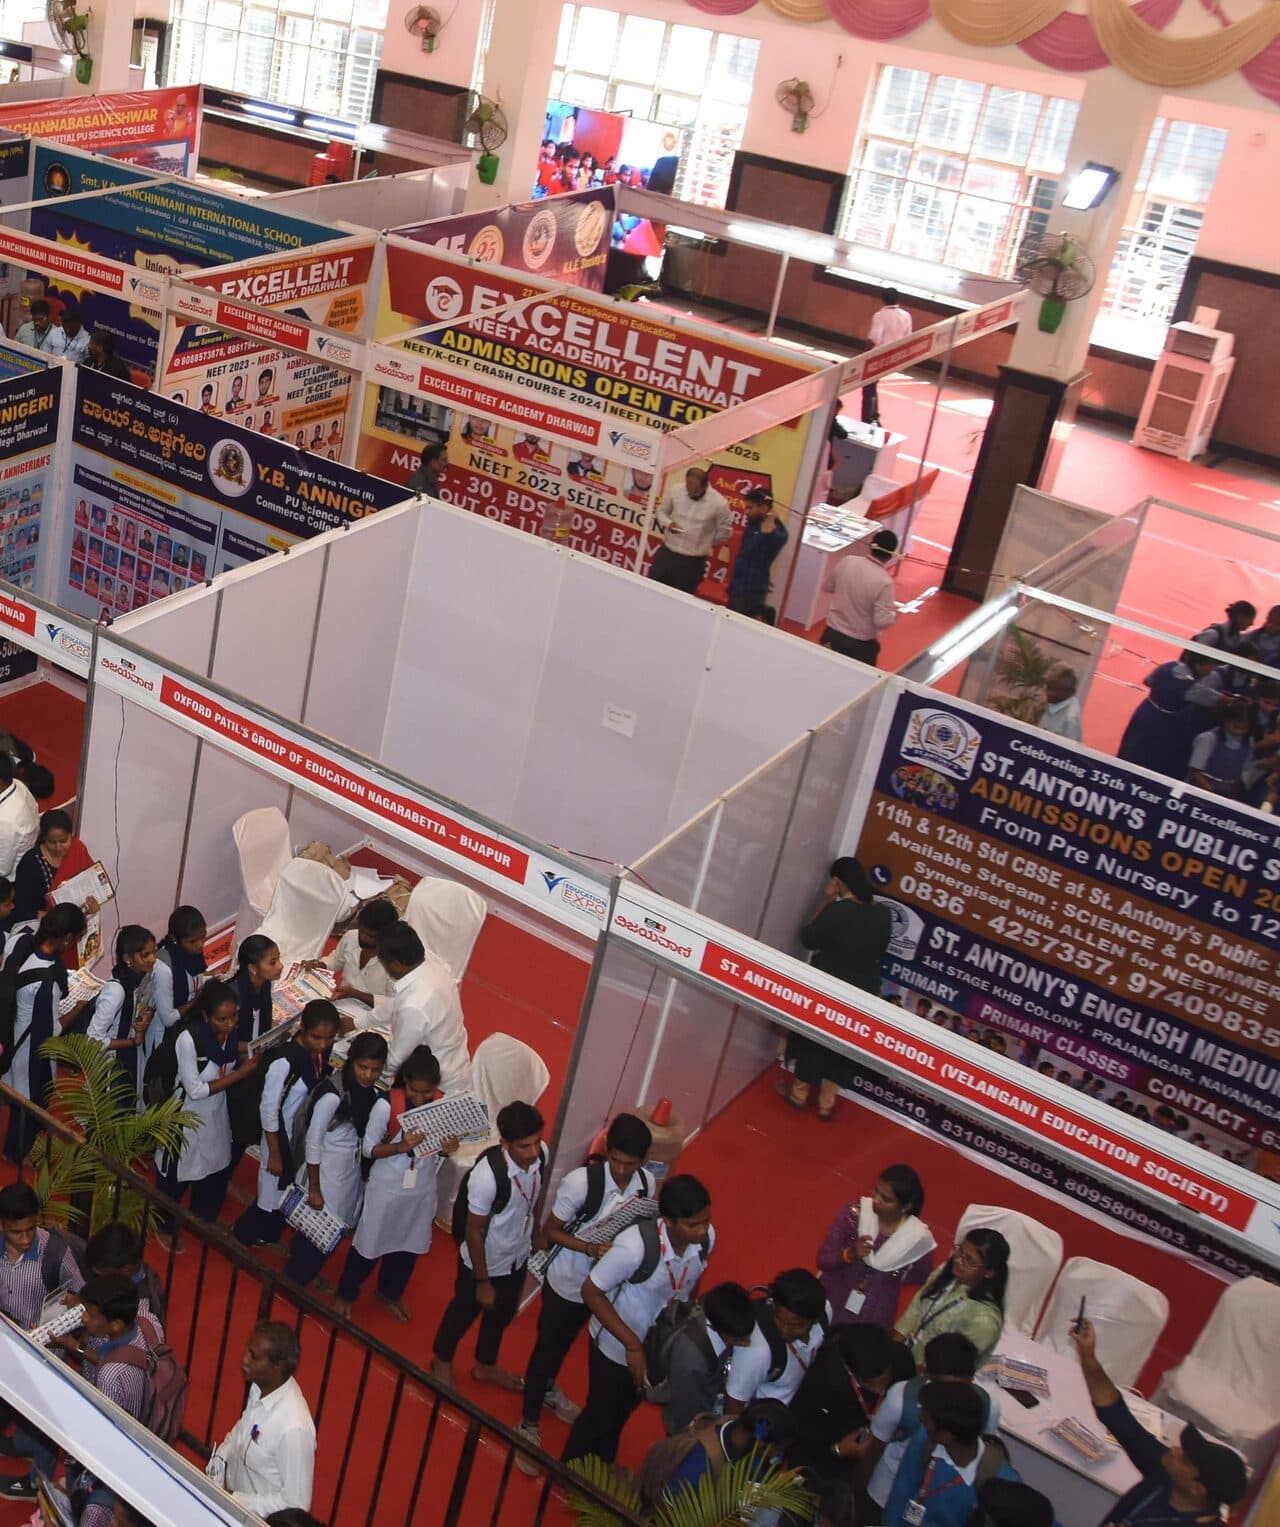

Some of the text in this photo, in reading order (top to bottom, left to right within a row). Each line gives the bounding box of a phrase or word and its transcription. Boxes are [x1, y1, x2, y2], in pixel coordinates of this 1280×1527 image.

[122, 124, 156, 136] COLLEGE
[186, 203, 303, 248] INTERNATIONAL SCHOOL
[48, 251, 86, 275] INSTITUTES
[86, 262, 122, 284] DHARWAD
[224, 305, 304, 337] EXCELLENT ACADEMY
[246, 322, 276, 339] DHARWAD
[468, 317, 627, 378] NEET ACADEMY,
[470, 285, 762, 396] EXCELLENT
[441, 330, 662, 414] ADMISSIONS OPEN
[472, 362, 602, 410] CRASH COURSE 2024
[16, 424, 49, 442] Dharwad
[422, 374, 596, 438] EXCELLENT ACADEMY DHARWAD
[3, 454, 52, 479] ANNIGERIAN'S
[468, 454, 513, 479] NEET
[516, 470, 562, 498] 2023
[173, 690, 512, 868] OXFORD PATIL'S GROUP EDUCATION NAGARABETTA BIJAPUR
[1008, 740, 1270, 844] Celebrating Excellence
[968, 778, 1249, 898] ADMISSIONS OPEN
[981, 750, 1258, 872] ST. ANTONY'S PUBLIC
[887, 830, 1156, 949] Available Stream SCIENCE
[980, 809, 1200, 910] From Pre Nursery
[900, 875, 966, 916] 0836
[1011, 854, 1270, 972] CBSE Antony's Public
[914, 861, 1270, 1016] Synergised ALLEN NEET/JEE
[890, 964, 960, 1002] PRIMARY
[930, 926, 1190, 1054] ST. ANTONY'S ENGLISH
[946, 966, 990, 992] STAGE
[980, 1004, 1130, 1080] PRIMARY CLASSES
[720, 958, 1230, 1213] ST. ANTHONY PUBLIC SCHOOL (VELANGANI EDUCATION SOCIETY)
[1148, 1076, 1248, 1132] CONTACT
